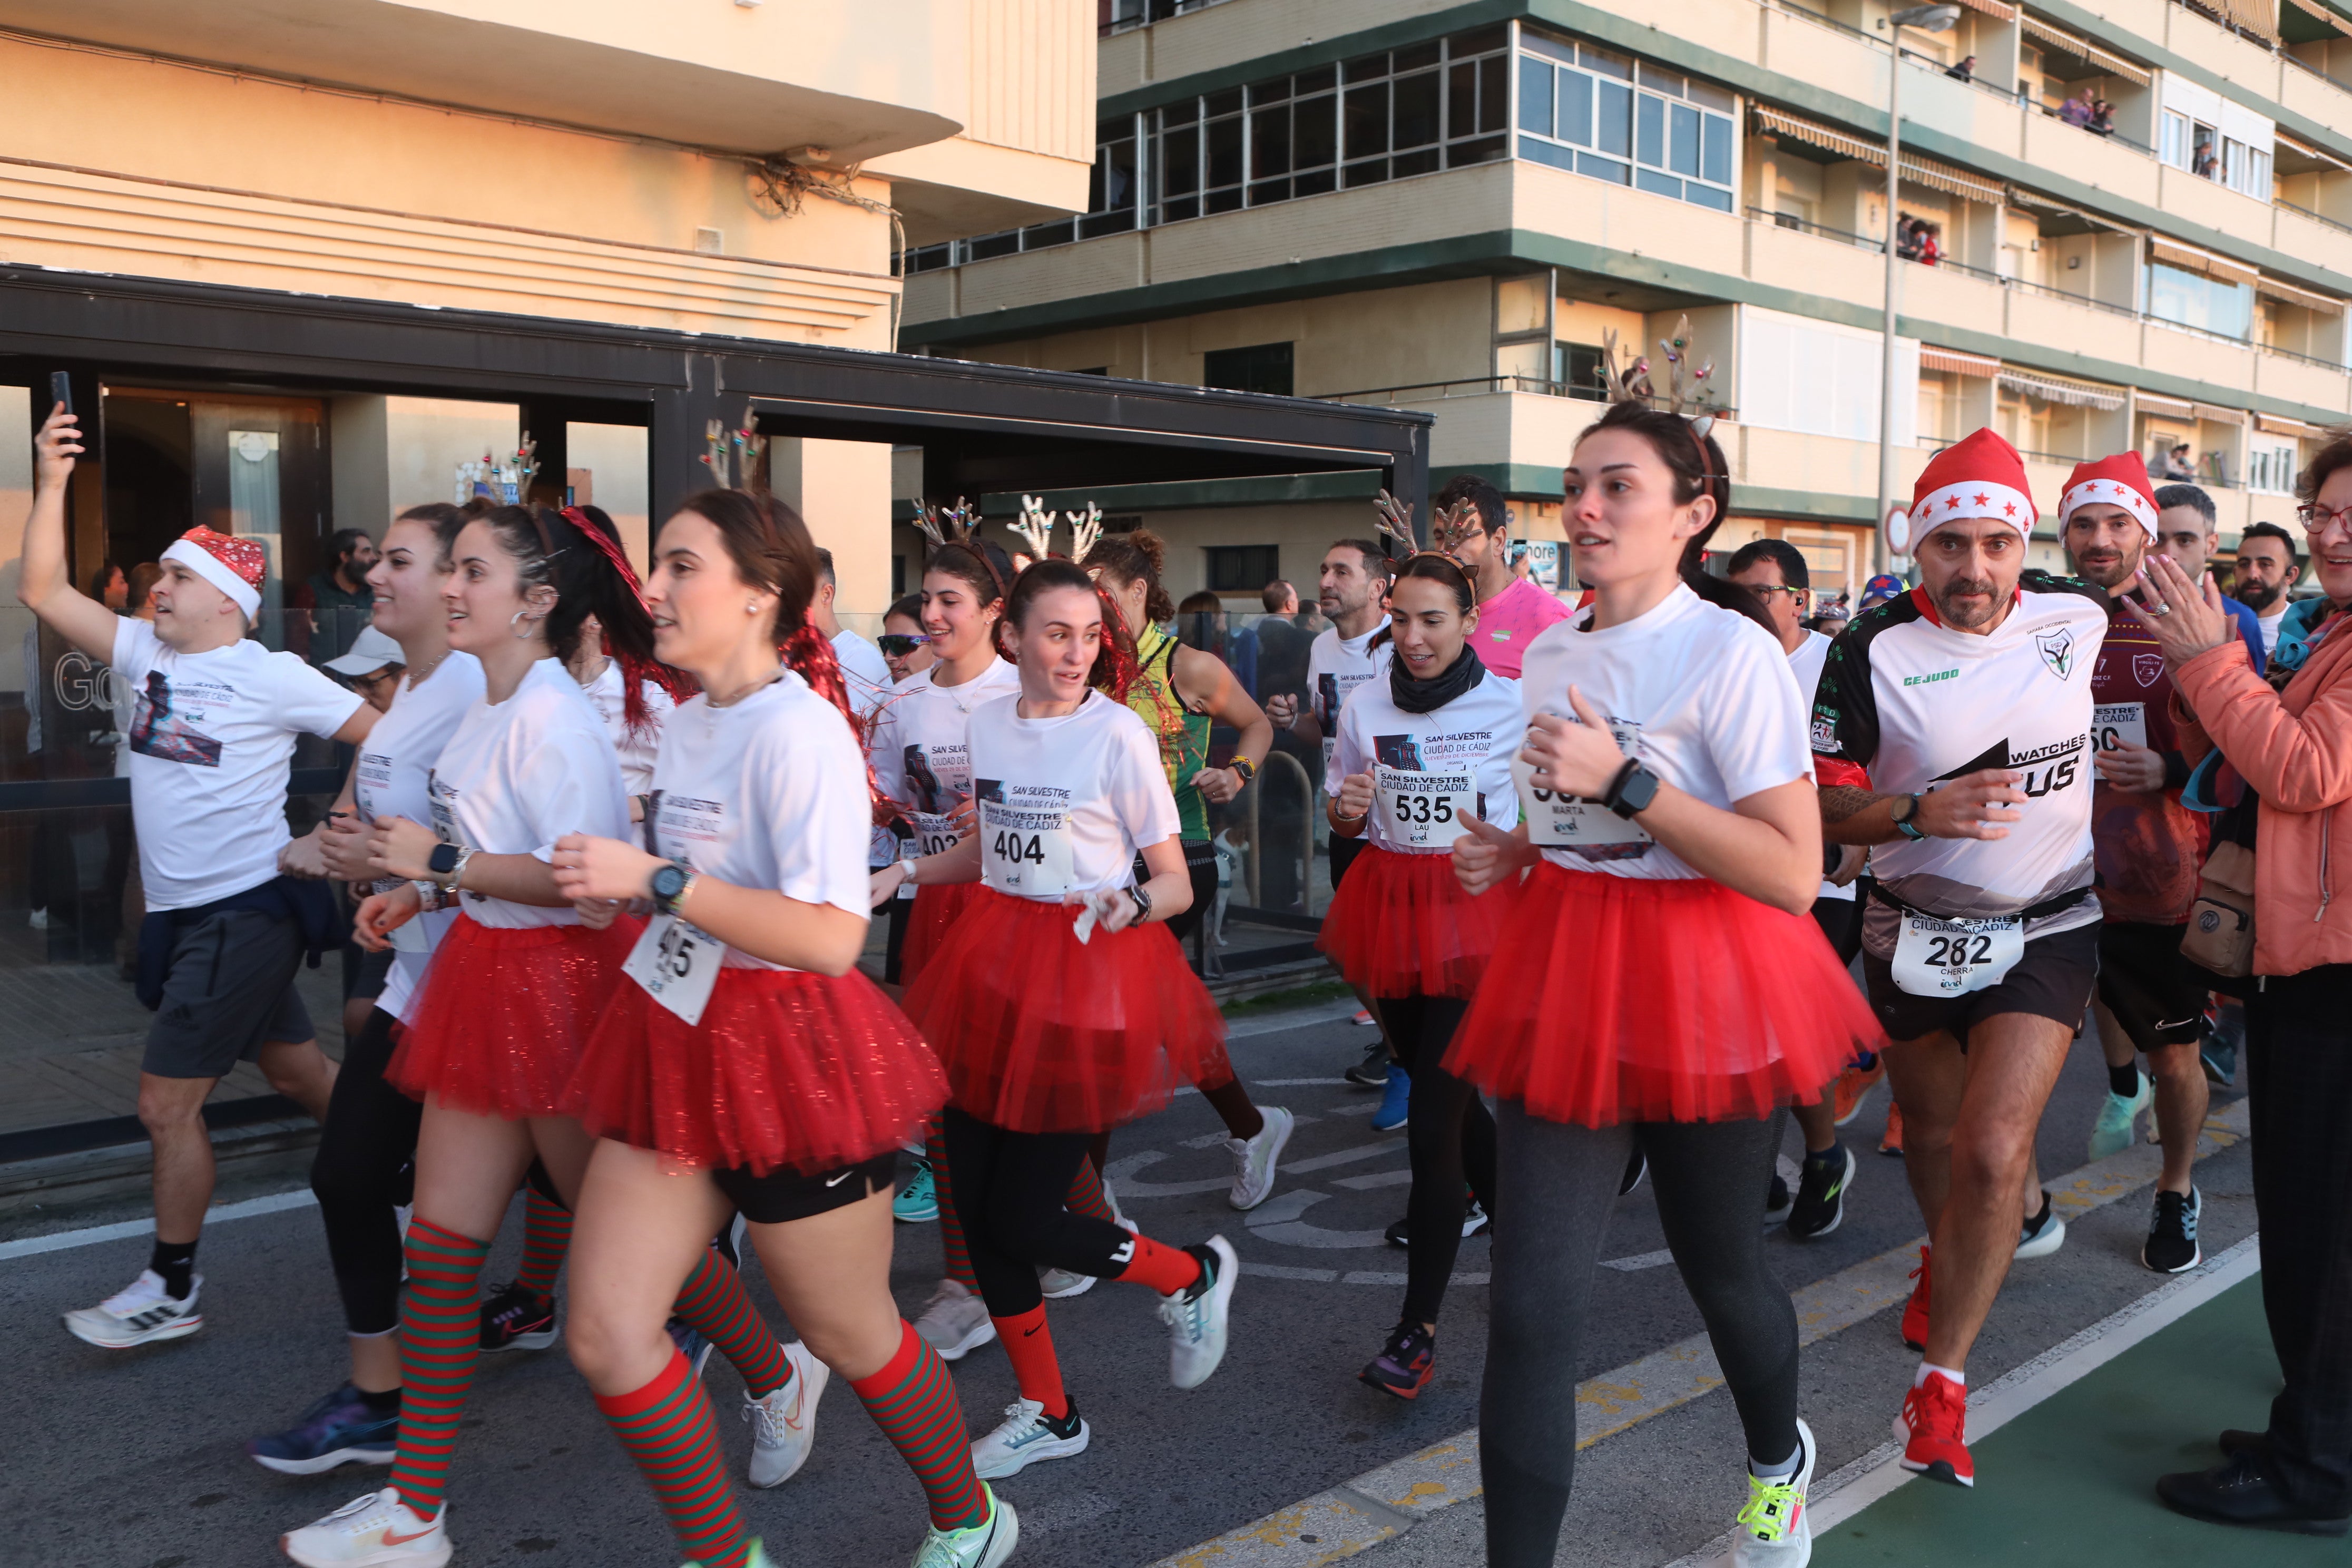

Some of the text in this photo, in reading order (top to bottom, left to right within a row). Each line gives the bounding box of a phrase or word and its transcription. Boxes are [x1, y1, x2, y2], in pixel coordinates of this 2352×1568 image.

[1445, 732, 1492, 741] SILVESTRE
[948, 744, 968, 753] SILVE
[1424, 744, 1454, 754] CIUDAD
[1468, 742, 1491, 751] CÁDIZ
[2011, 733, 2086, 763] WATCHES
[932, 758, 955, 766] CIUDAD
[1381, 773, 1400, 782] SAN
[1381, 780, 1416, 791] CIUDAD
[1012, 786, 1071, 799] SAN SILVESTRE
[1001, 809, 1062, 820] SILVESTRE
[1396, 795, 1453, 823] 535
[1552, 805, 1585, 815] MARTA
[985, 812, 1011, 827] CIUDAD
[1012, 818, 1024, 829] DE
[995, 830, 1045, 865] 404
[1912, 920, 1958, 933] CIUDAD
[1957, 916, 2012, 928] VESTRE
[1924, 935, 1992, 967] 282
[1941, 967, 1974, 975] CHERRA
